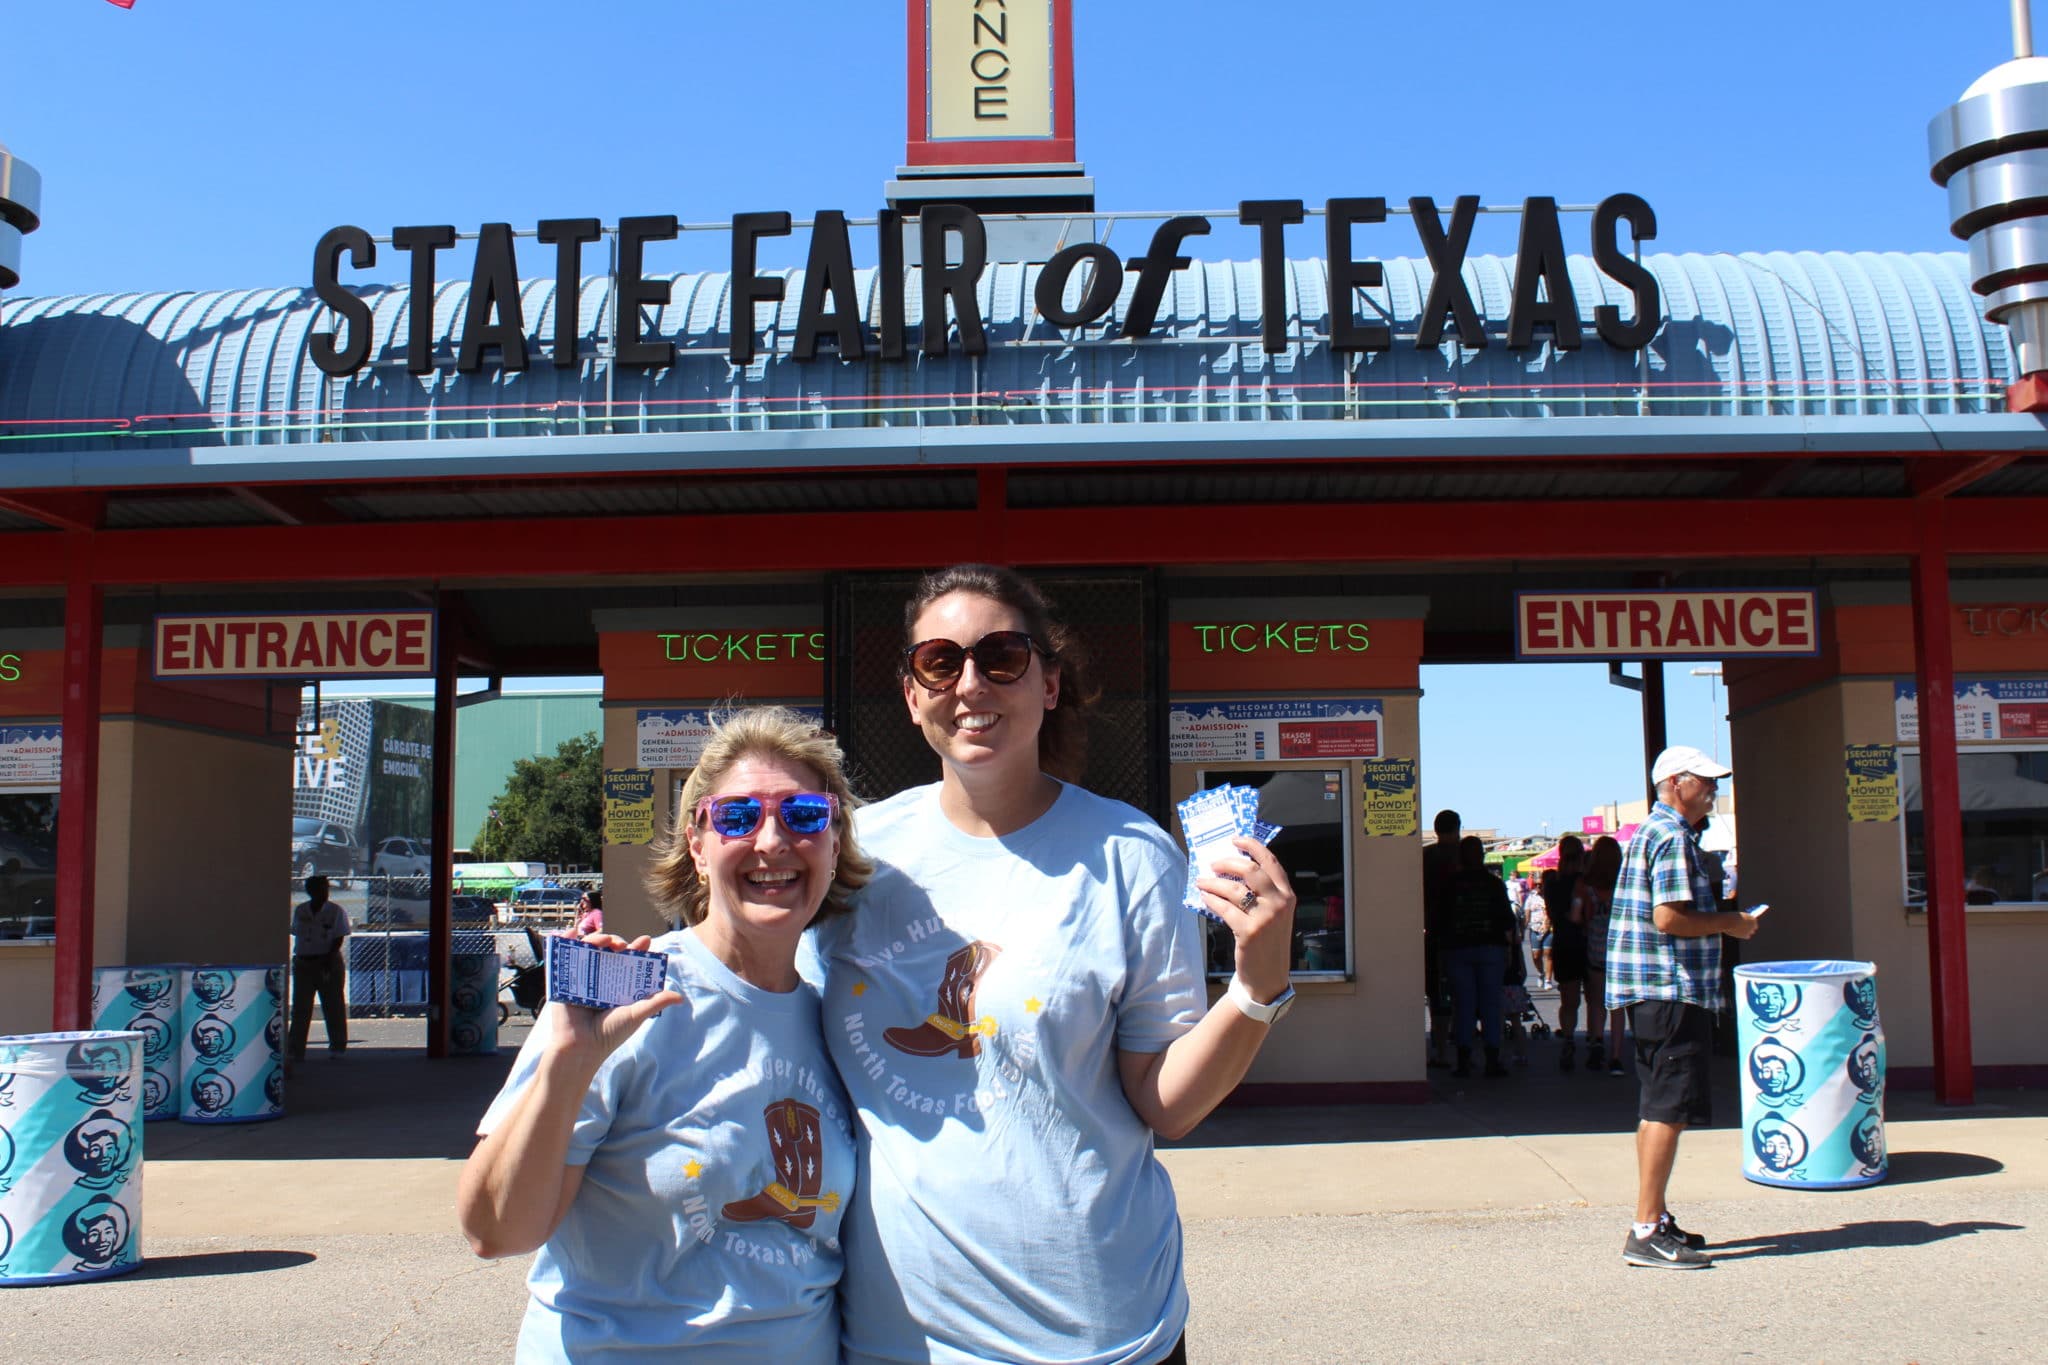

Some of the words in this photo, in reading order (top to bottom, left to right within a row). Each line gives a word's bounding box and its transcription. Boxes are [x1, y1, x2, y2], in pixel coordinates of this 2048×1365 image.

[971, 0, 1010, 119] NCE
[310, 215, 677, 377] STATE
[729, 204, 988, 365] FAIR
[1034, 216, 1211, 339] of
[1238, 193, 1661, 353] TEXAS
[1526, 597, 1809, 649] ENTRANCE
[1193, 621, 1370, 653] TICKETS
[162, 618, 426, 669] ENTRANCE
[1189, 723, 1241, 731] ADMISSION
[421, 744, 432, 759] DE
[1850, 750, 1891, 758] SECURITY
[1367, 764, 1410, 772] SECURITY
[1855, 759, 1889, 767] NOTICE
[608, 774, 649, 782] SECURITY
[1372, 773, 1406, 782] NOTICE
[612, 783, 646, 791] NOTICE
[1852, 786, 1895, 794] HOWDY!
[1368, 801, 1412, 809] HOWDY!
[608, 809, 650, 818] HOWDY!
[644, 961, 654, 989] TEXAS
[844, 1012, 887, 1081] North
[885, 1075, 946, 1115] Texas
[798, 1066, 825, 1103] the
[724, 1231, 785, 1266] Texas
